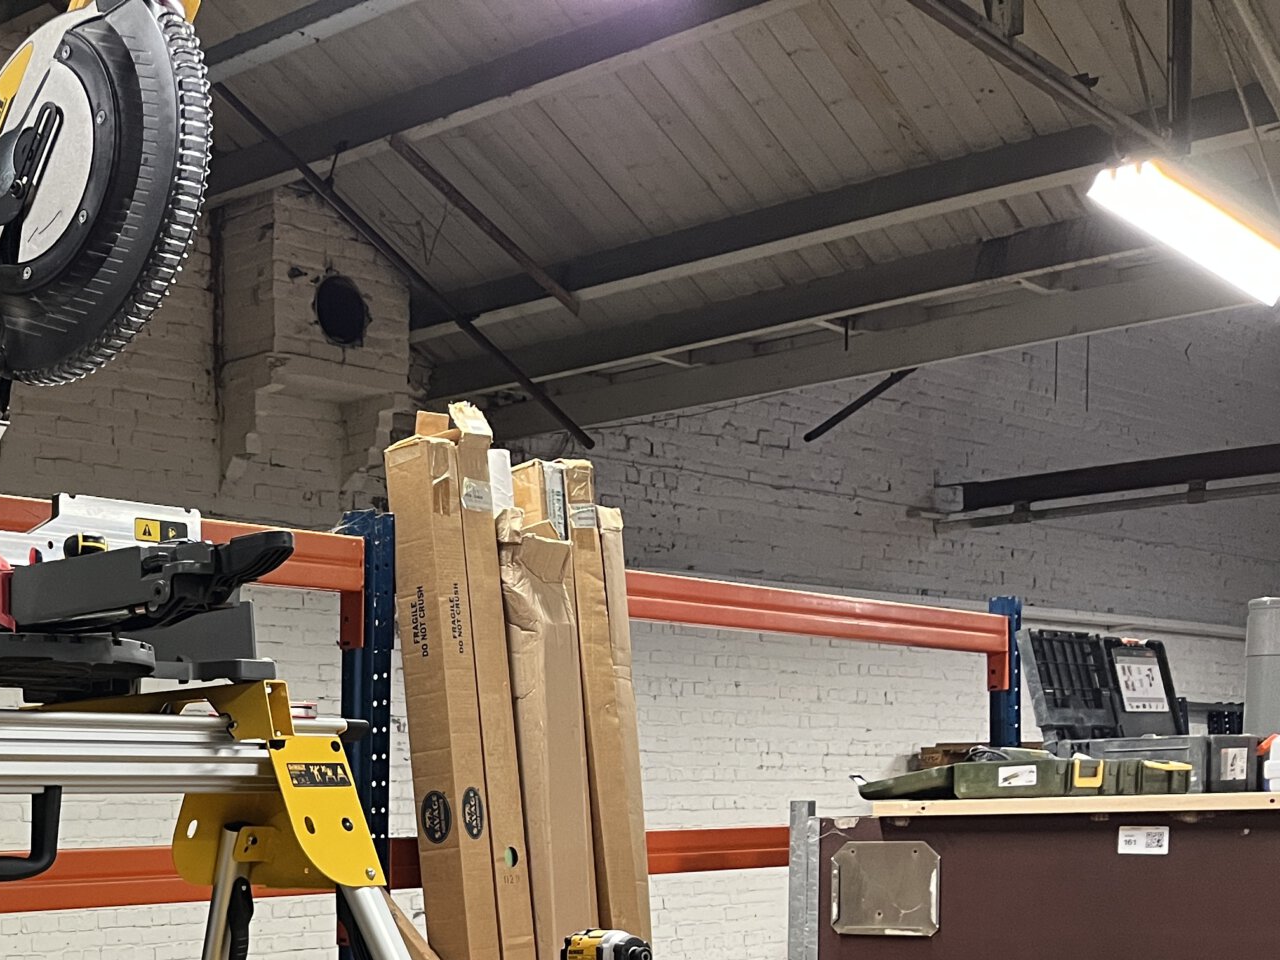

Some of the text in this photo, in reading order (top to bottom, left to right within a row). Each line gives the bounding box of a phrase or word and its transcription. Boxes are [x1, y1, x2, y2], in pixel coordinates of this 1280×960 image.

[410, 602, 421, 645] FRAGILE
[416, 585, 430, 658] DO NOT CRUSH
[449, 597, 459, 639] FRAGILE
[452, 583, 465, 654] DO NOT CRUSH
[1123, 838, 1137, 846] 161
